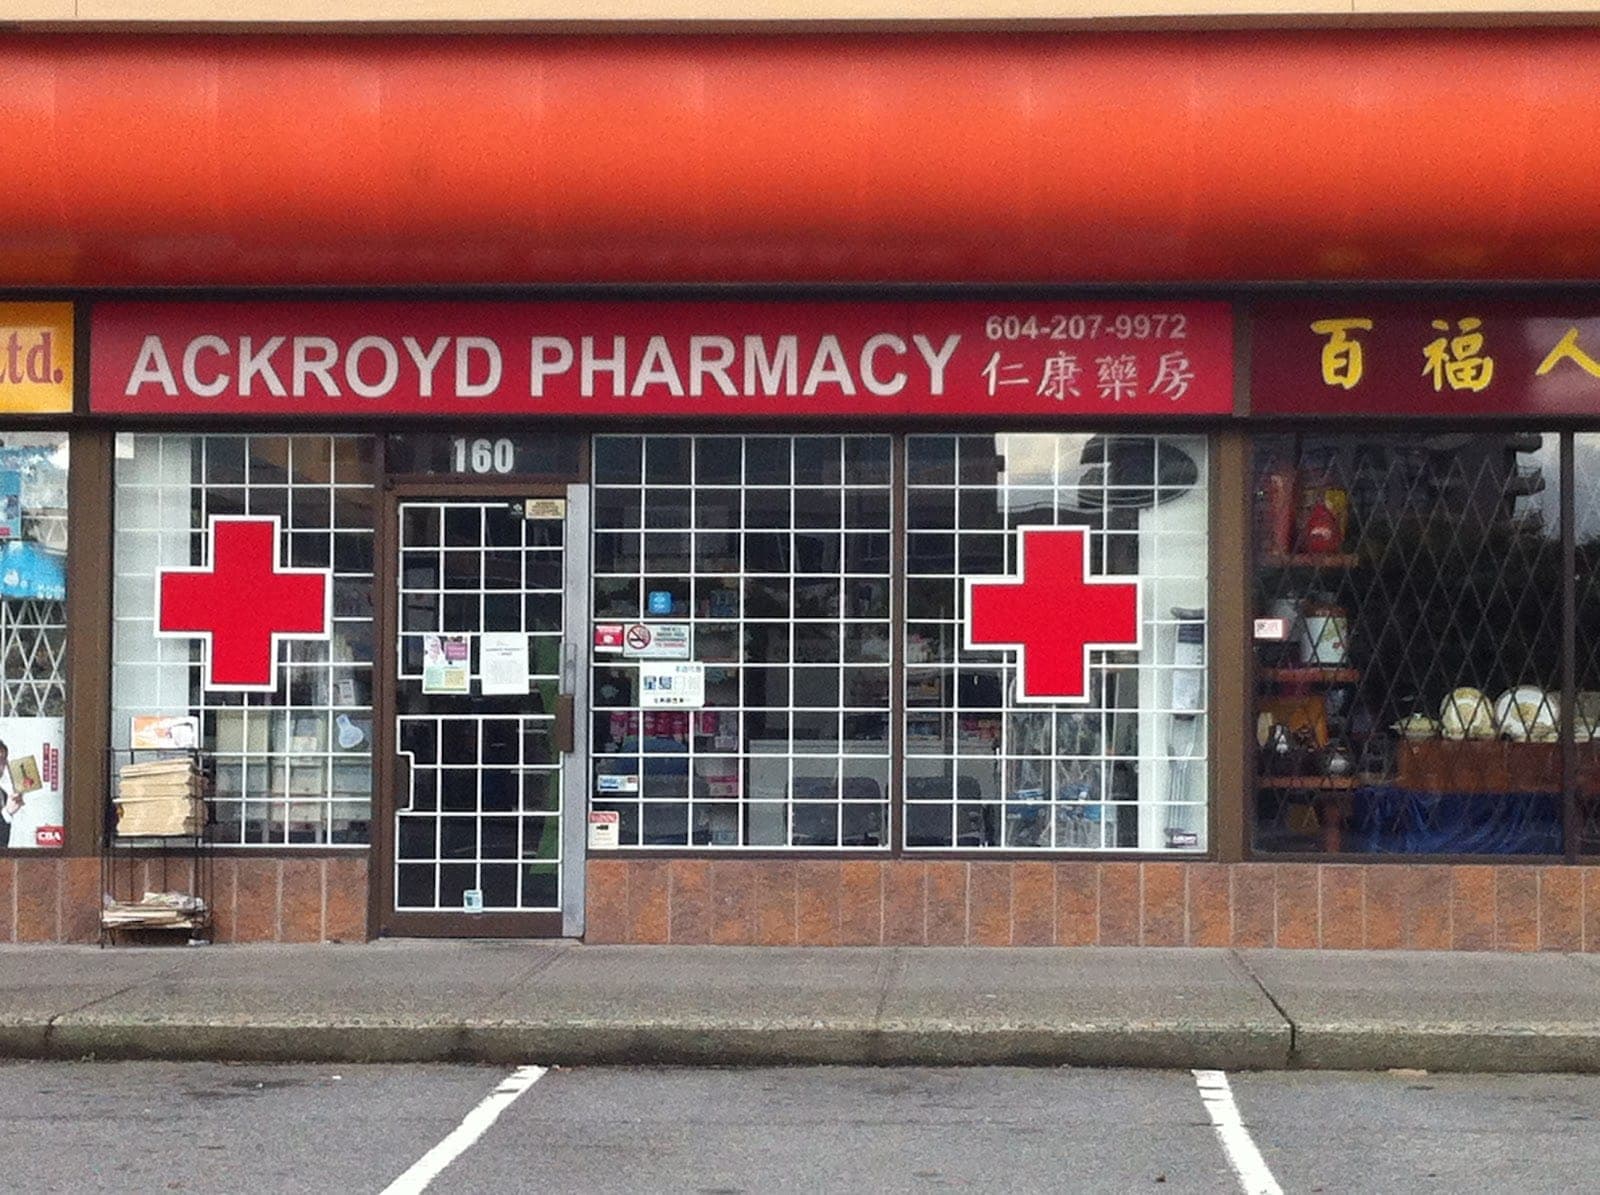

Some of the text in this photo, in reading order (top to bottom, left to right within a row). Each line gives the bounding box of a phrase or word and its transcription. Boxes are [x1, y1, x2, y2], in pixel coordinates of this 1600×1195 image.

[985, 314, 1188, 341] 604-207-9972
[0, 331, 64, 385] td.
[125, 333, 961, 398] ACKROYD PHARMACY
[981, 350, 1196, 401] 仁康藥房
[454, 438, 515, 474] 160
